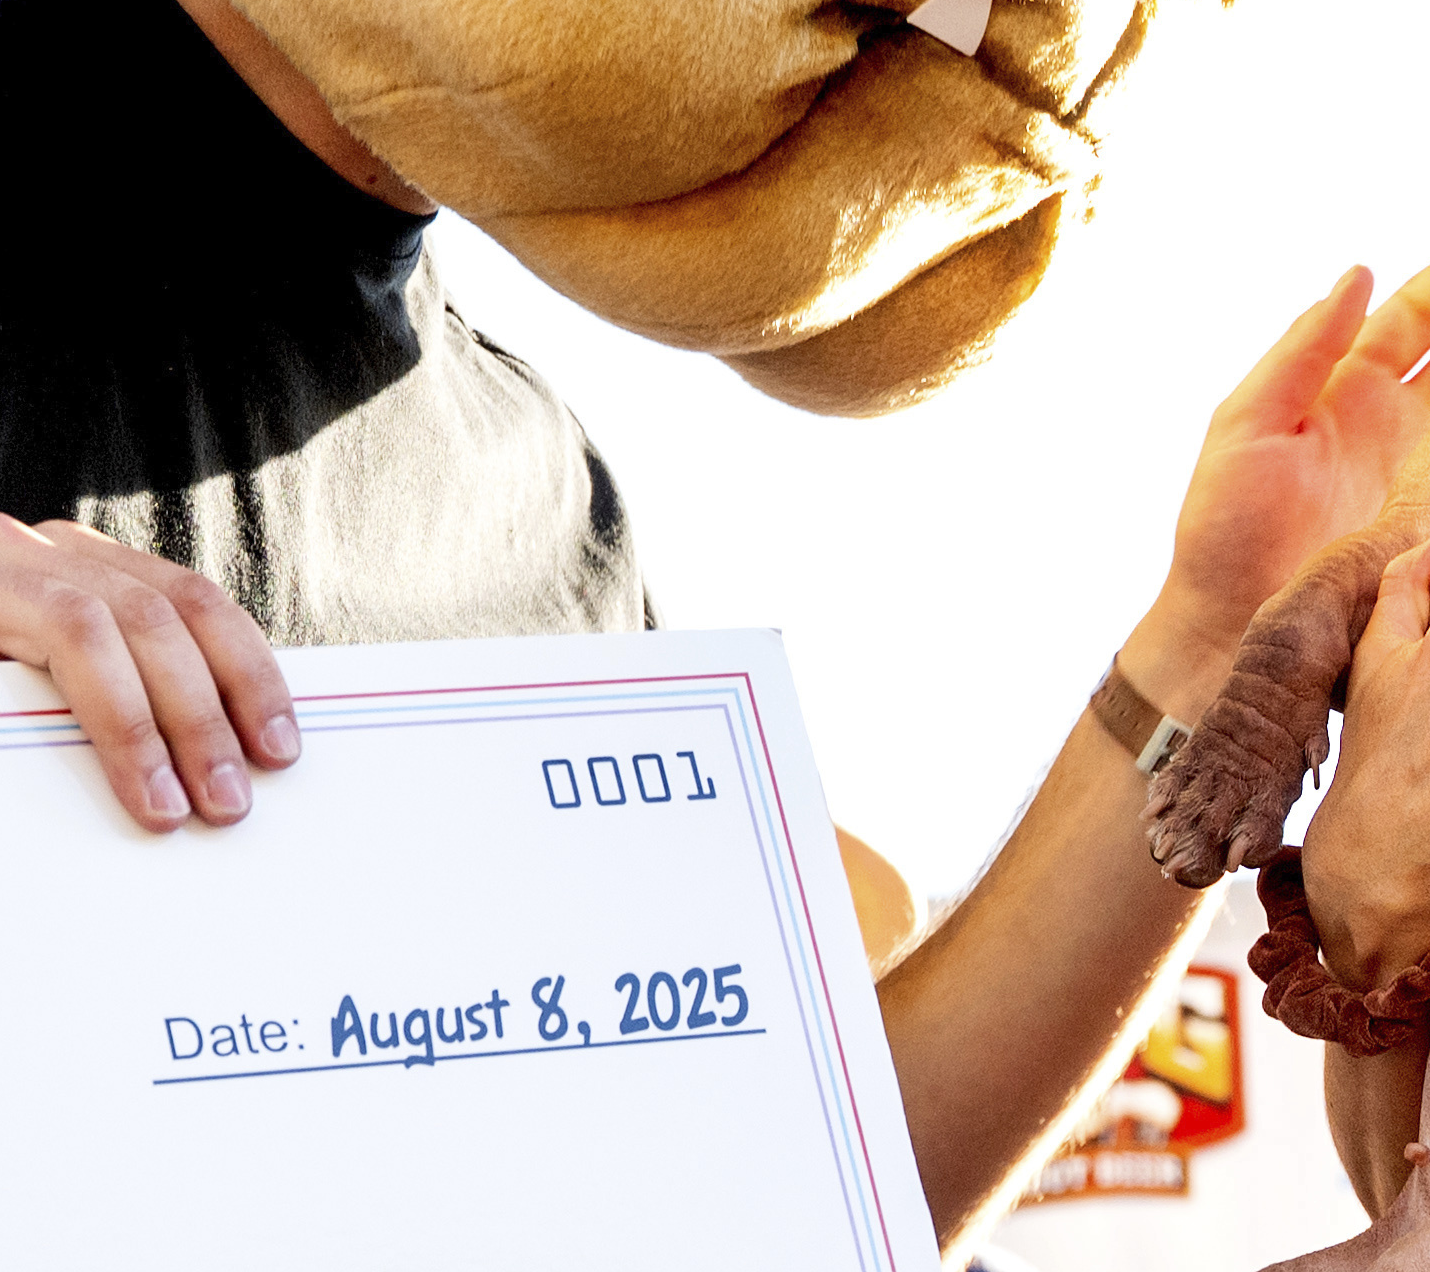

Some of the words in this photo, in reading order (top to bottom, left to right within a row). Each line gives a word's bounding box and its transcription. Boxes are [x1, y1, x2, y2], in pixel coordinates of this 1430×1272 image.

[541, 751, 717, 809] 0001
[164, 1013, 304, 1062] Date:
[331, 989, 510, 1068] August
[531, 975, 592, 1046] 8,
[615, 964, 749, 1035] 2025
